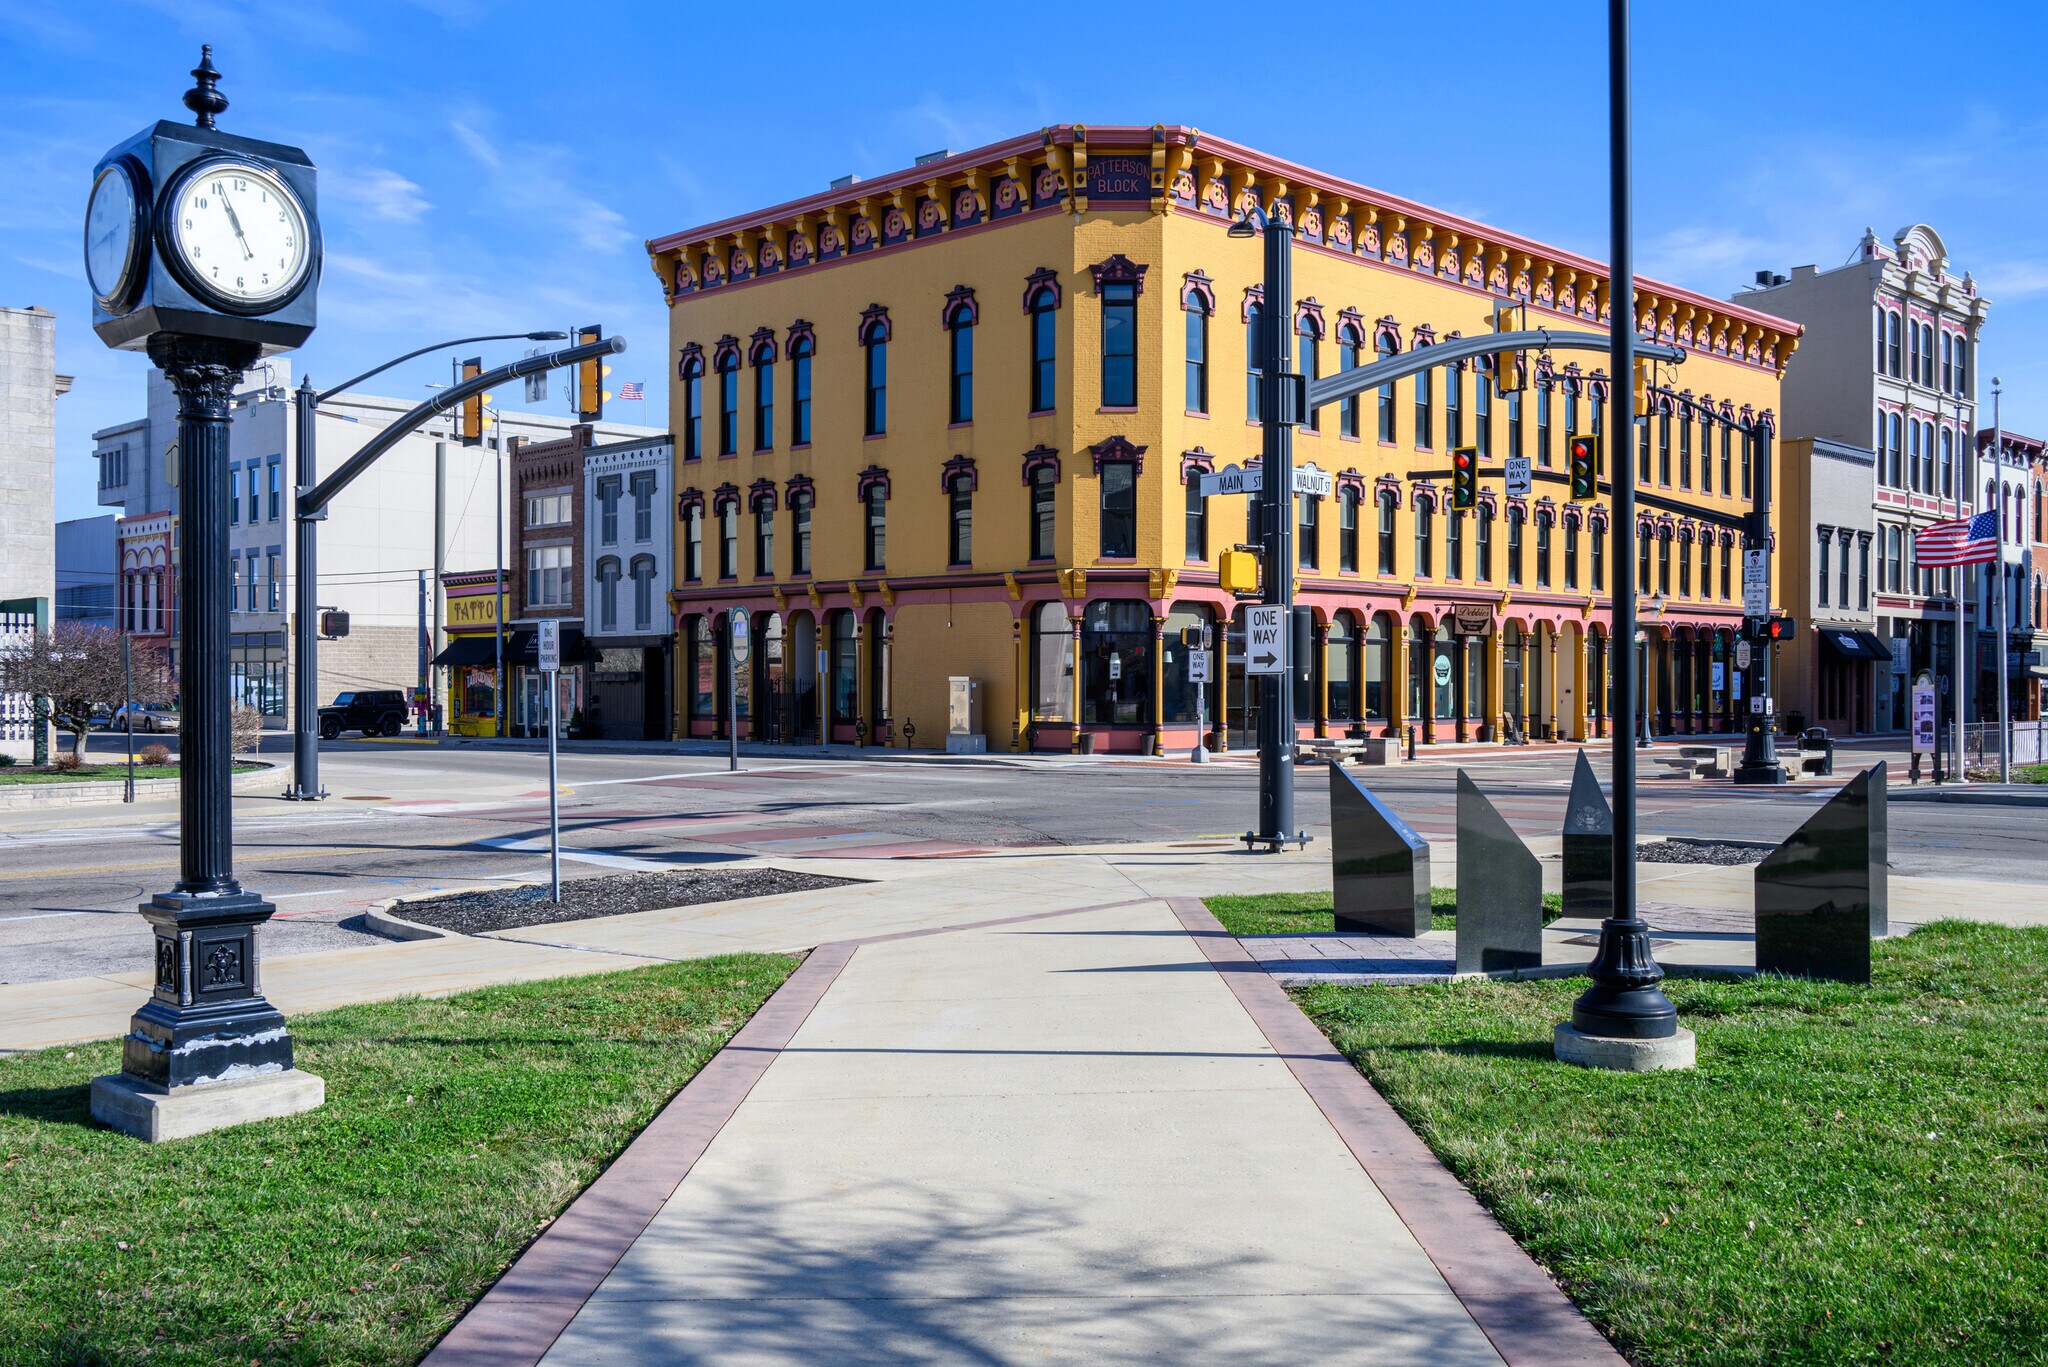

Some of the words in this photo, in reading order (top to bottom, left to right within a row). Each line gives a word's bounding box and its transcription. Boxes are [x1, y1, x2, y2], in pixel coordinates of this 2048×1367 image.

[1087, 159, 1150, 180] PATTERSON
[234, 179, 247, 192] 12
[1098, 179, 1139, 192] BLOCK
[194, 196, 208, 210] 10
[262, 191, 266, 203] 1
[278, 211, 285, 223] 2
[185, 218, 193, 231] 9
[286, 236, 293, 248] 3
[193, 246, 201, 258] 8
[212, 266, 219, 278] 7
[236, 276, 244, 288] 6
[261, 273, 269, 285] 5
[1509, 461, 1526, 469] ONE
[1509, 471, 1526, 479] WAY
[1219, 475, 1243, 491] MAIN
[1253, 475, 1262, 488] ST
[1296, 473, 1324, 491] WALNUT
[1325, 481, 1331, 492] ST
[1457, 606, 1490, 617] Debbie's
[1253, 611, 1277, 626] ONE
[544, 628, 553, 637] ONE
[1253, 629, 1277, 645] WAY
[543, 641, 554, 650] HOUR
[541, 654, 557, 663] PARKING
